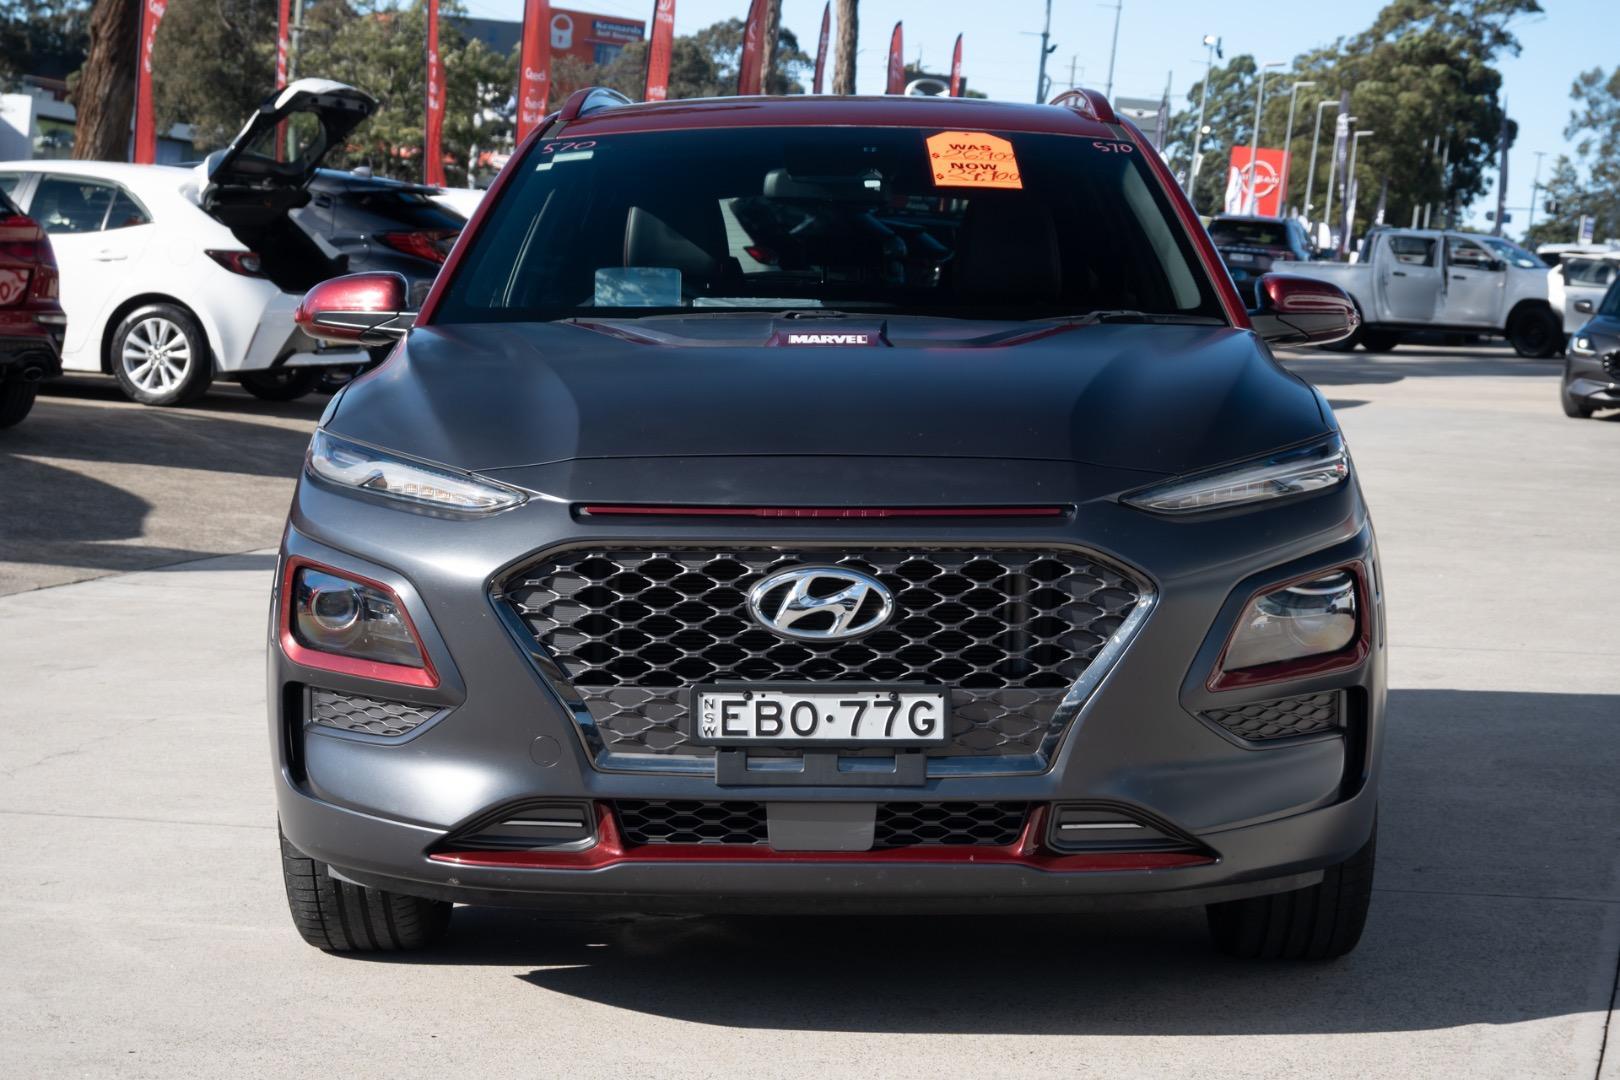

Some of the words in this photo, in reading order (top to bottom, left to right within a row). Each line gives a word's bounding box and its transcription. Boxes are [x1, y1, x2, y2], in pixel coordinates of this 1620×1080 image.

[542, 140, 596, 154] 570
[949, 143, 992, 151] WAS
[1092, 141, 1133, 153] 570
[950, 162, 997, 170] NOW
[787, 334, 868, 344] MARVEL
